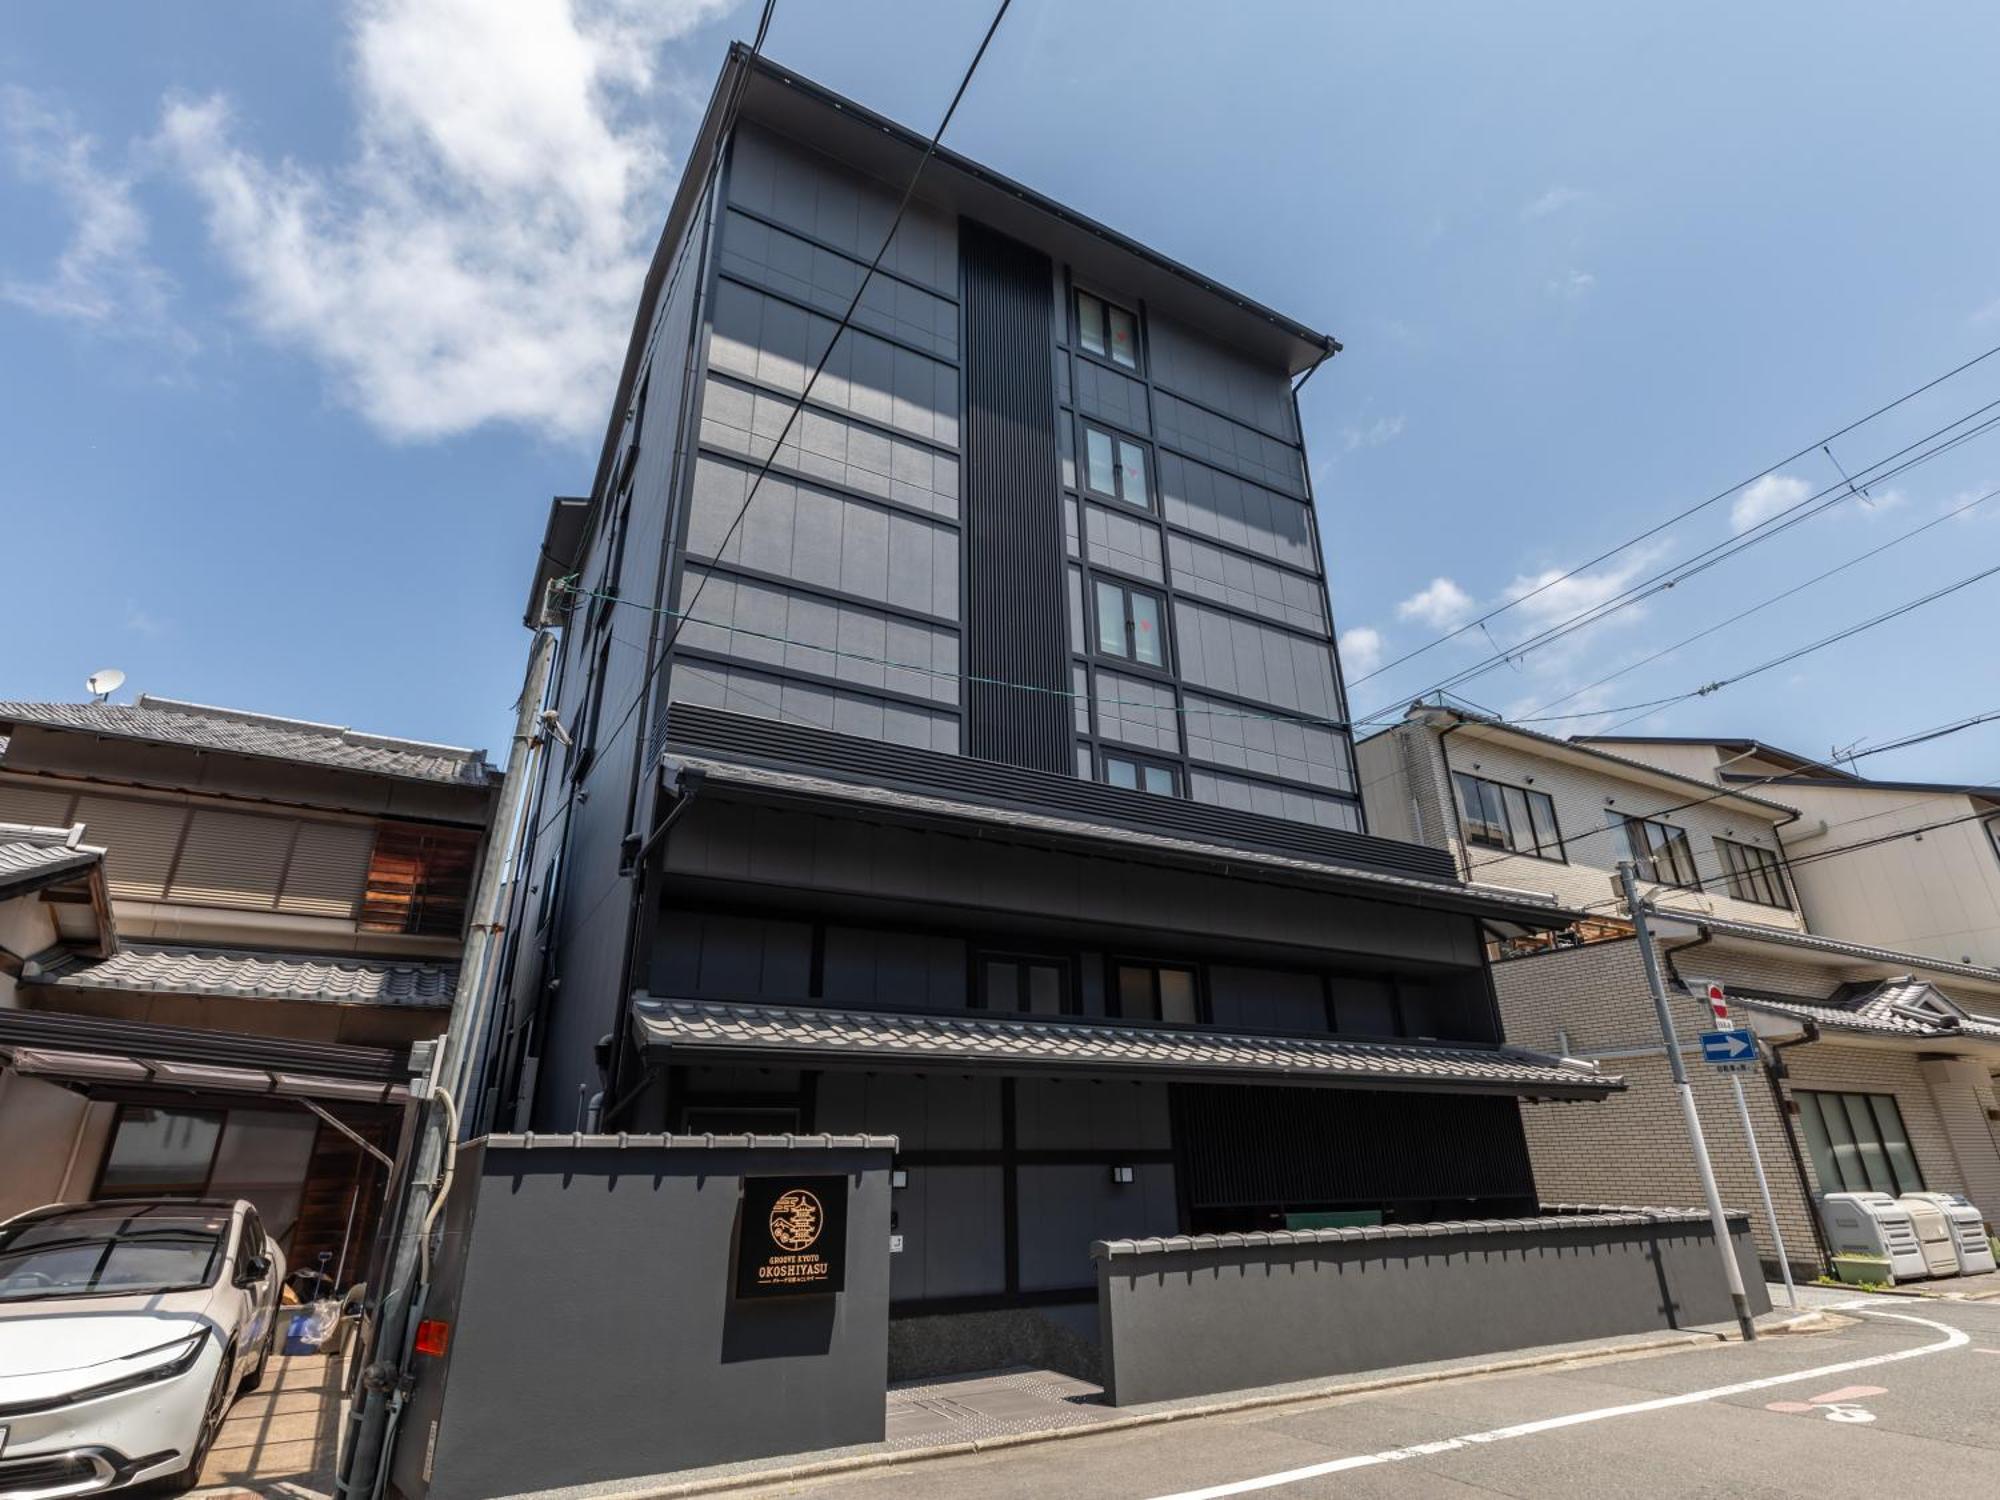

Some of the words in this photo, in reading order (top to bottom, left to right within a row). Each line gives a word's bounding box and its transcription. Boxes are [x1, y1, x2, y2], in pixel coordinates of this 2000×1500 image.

[769, 1256, 796, 1264] GROOVE
[797, 1254, 819, 1263] KYOTO
[759, 1263, 828, 1278] OKOSHIYASU
